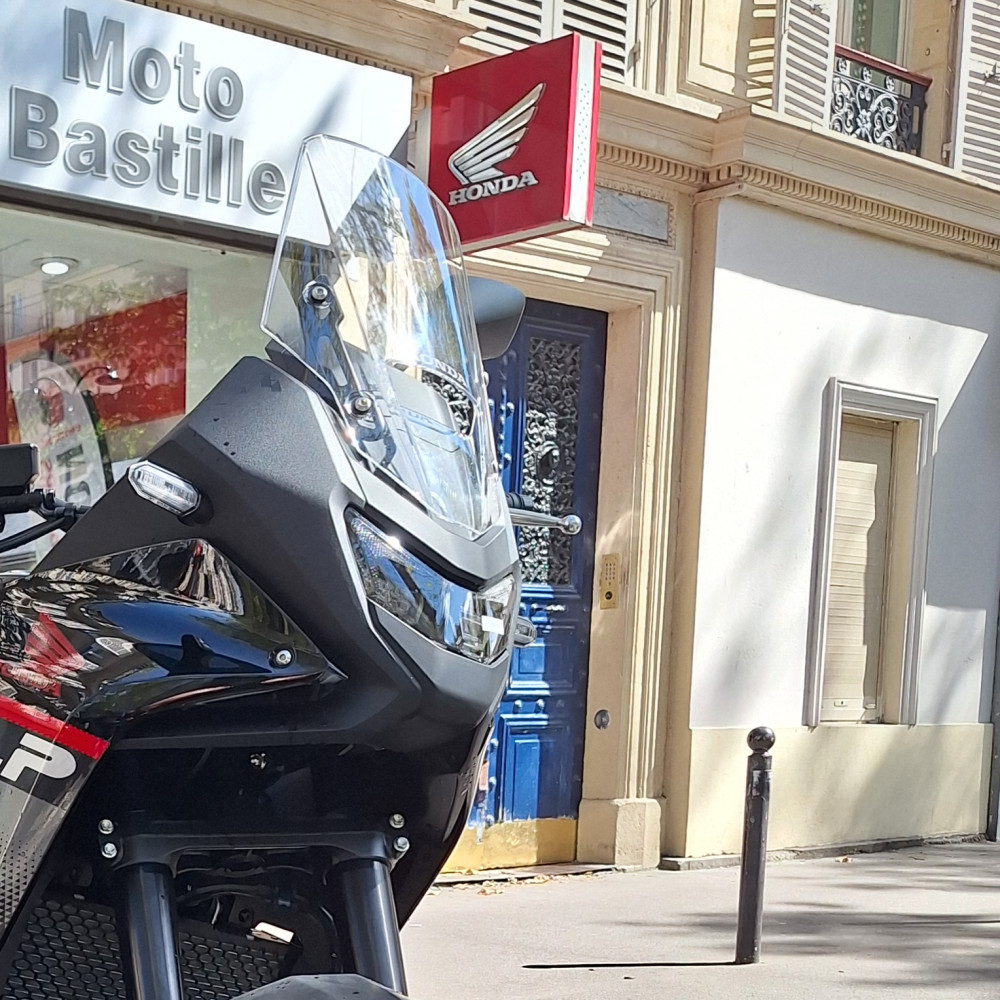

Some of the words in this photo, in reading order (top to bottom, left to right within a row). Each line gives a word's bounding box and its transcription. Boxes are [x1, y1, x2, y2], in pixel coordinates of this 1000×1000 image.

[63, 5, 244, 121] Moto
[8, 84, 286, 214] Bastille
[448, 170, 539, 206] HONDA
[416, 353, 468, 388] ONDA
